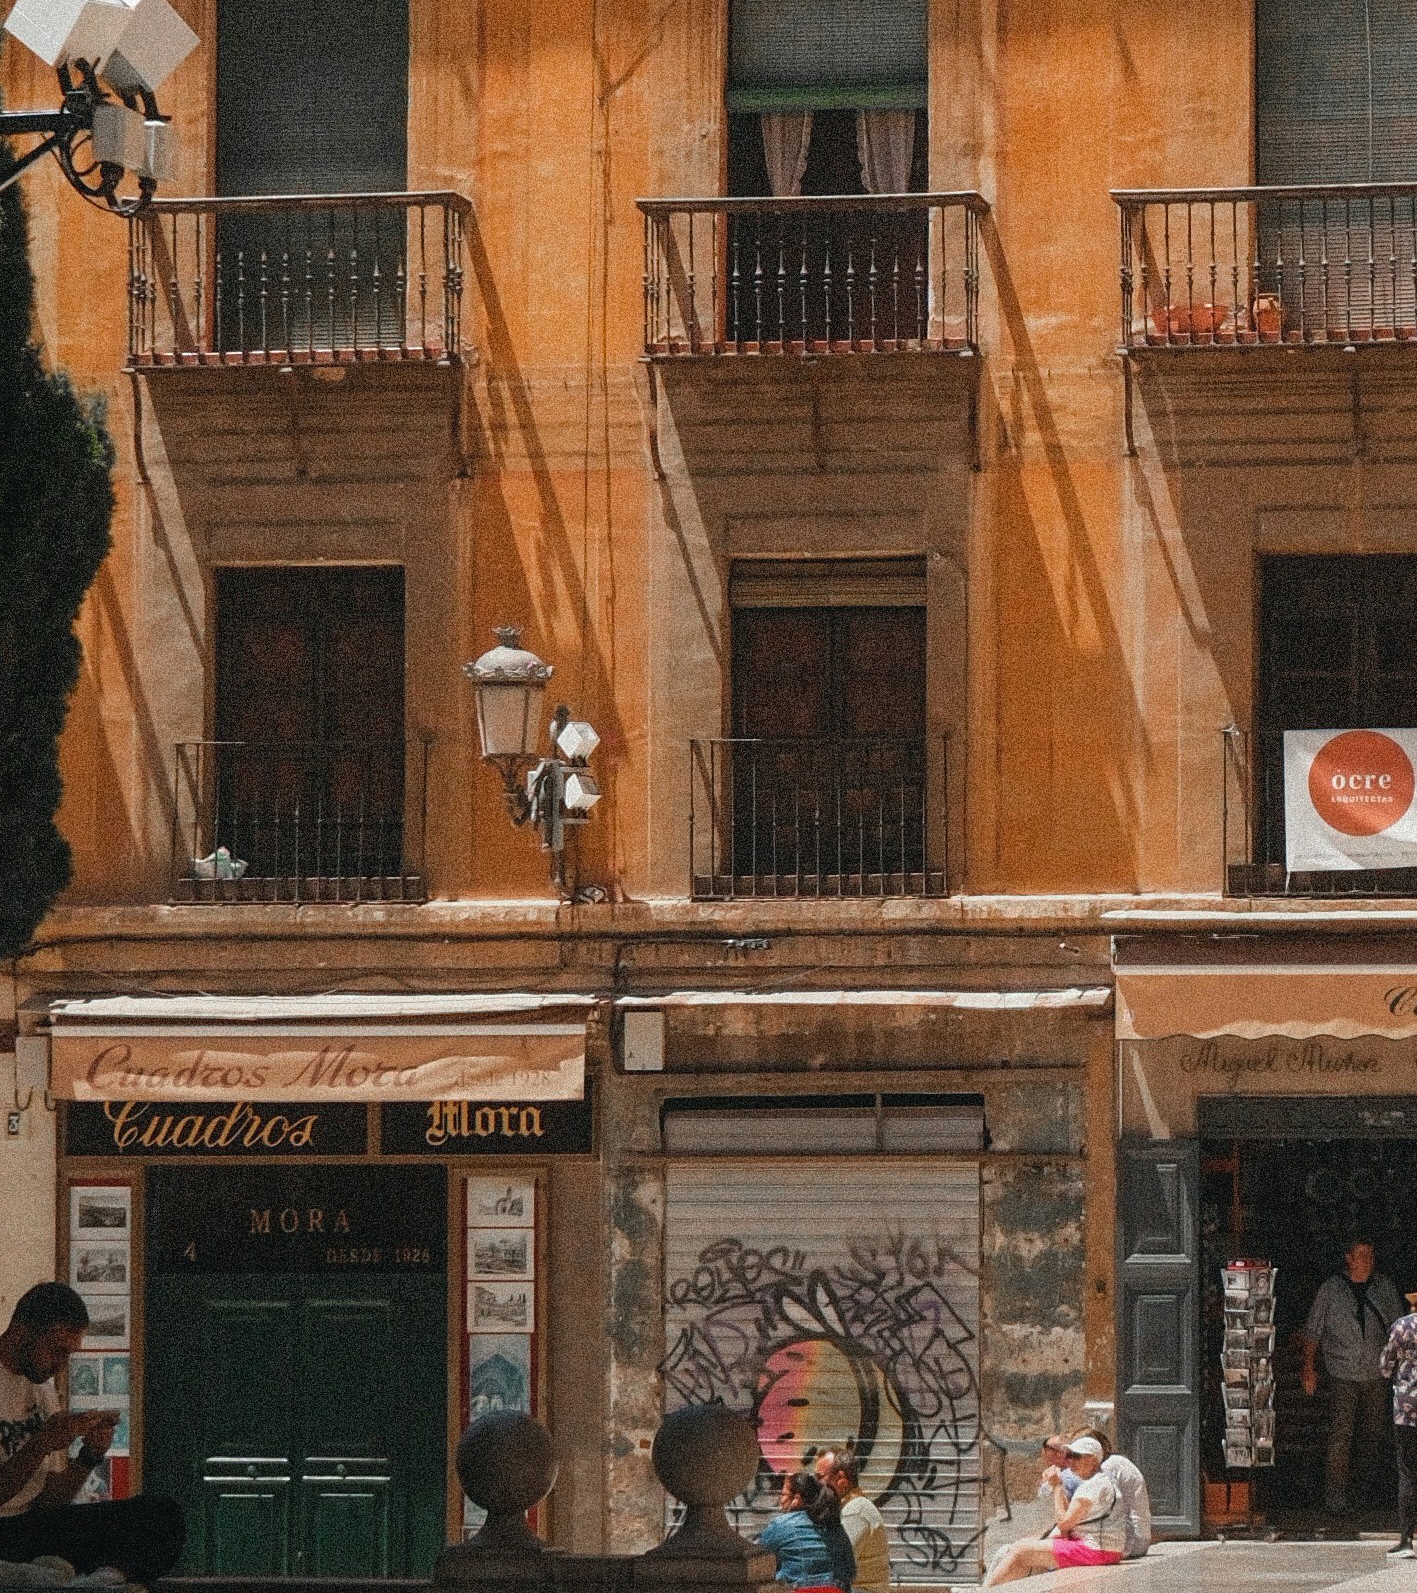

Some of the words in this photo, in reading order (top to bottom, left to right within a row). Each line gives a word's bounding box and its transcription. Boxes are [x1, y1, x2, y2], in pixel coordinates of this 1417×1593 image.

[85, 1043, 270, 1090] Cuadros
[282, 1043, 417, 1089] Mora
[103, 1100, 318, 1151] Cuadros
[425, 1100, 545, 1146] Mora
[249, 1207, 351, 1234] MORA
[183, 1242, 197, 1263] 4
[325, 1247, 383, 1264] DESDE
